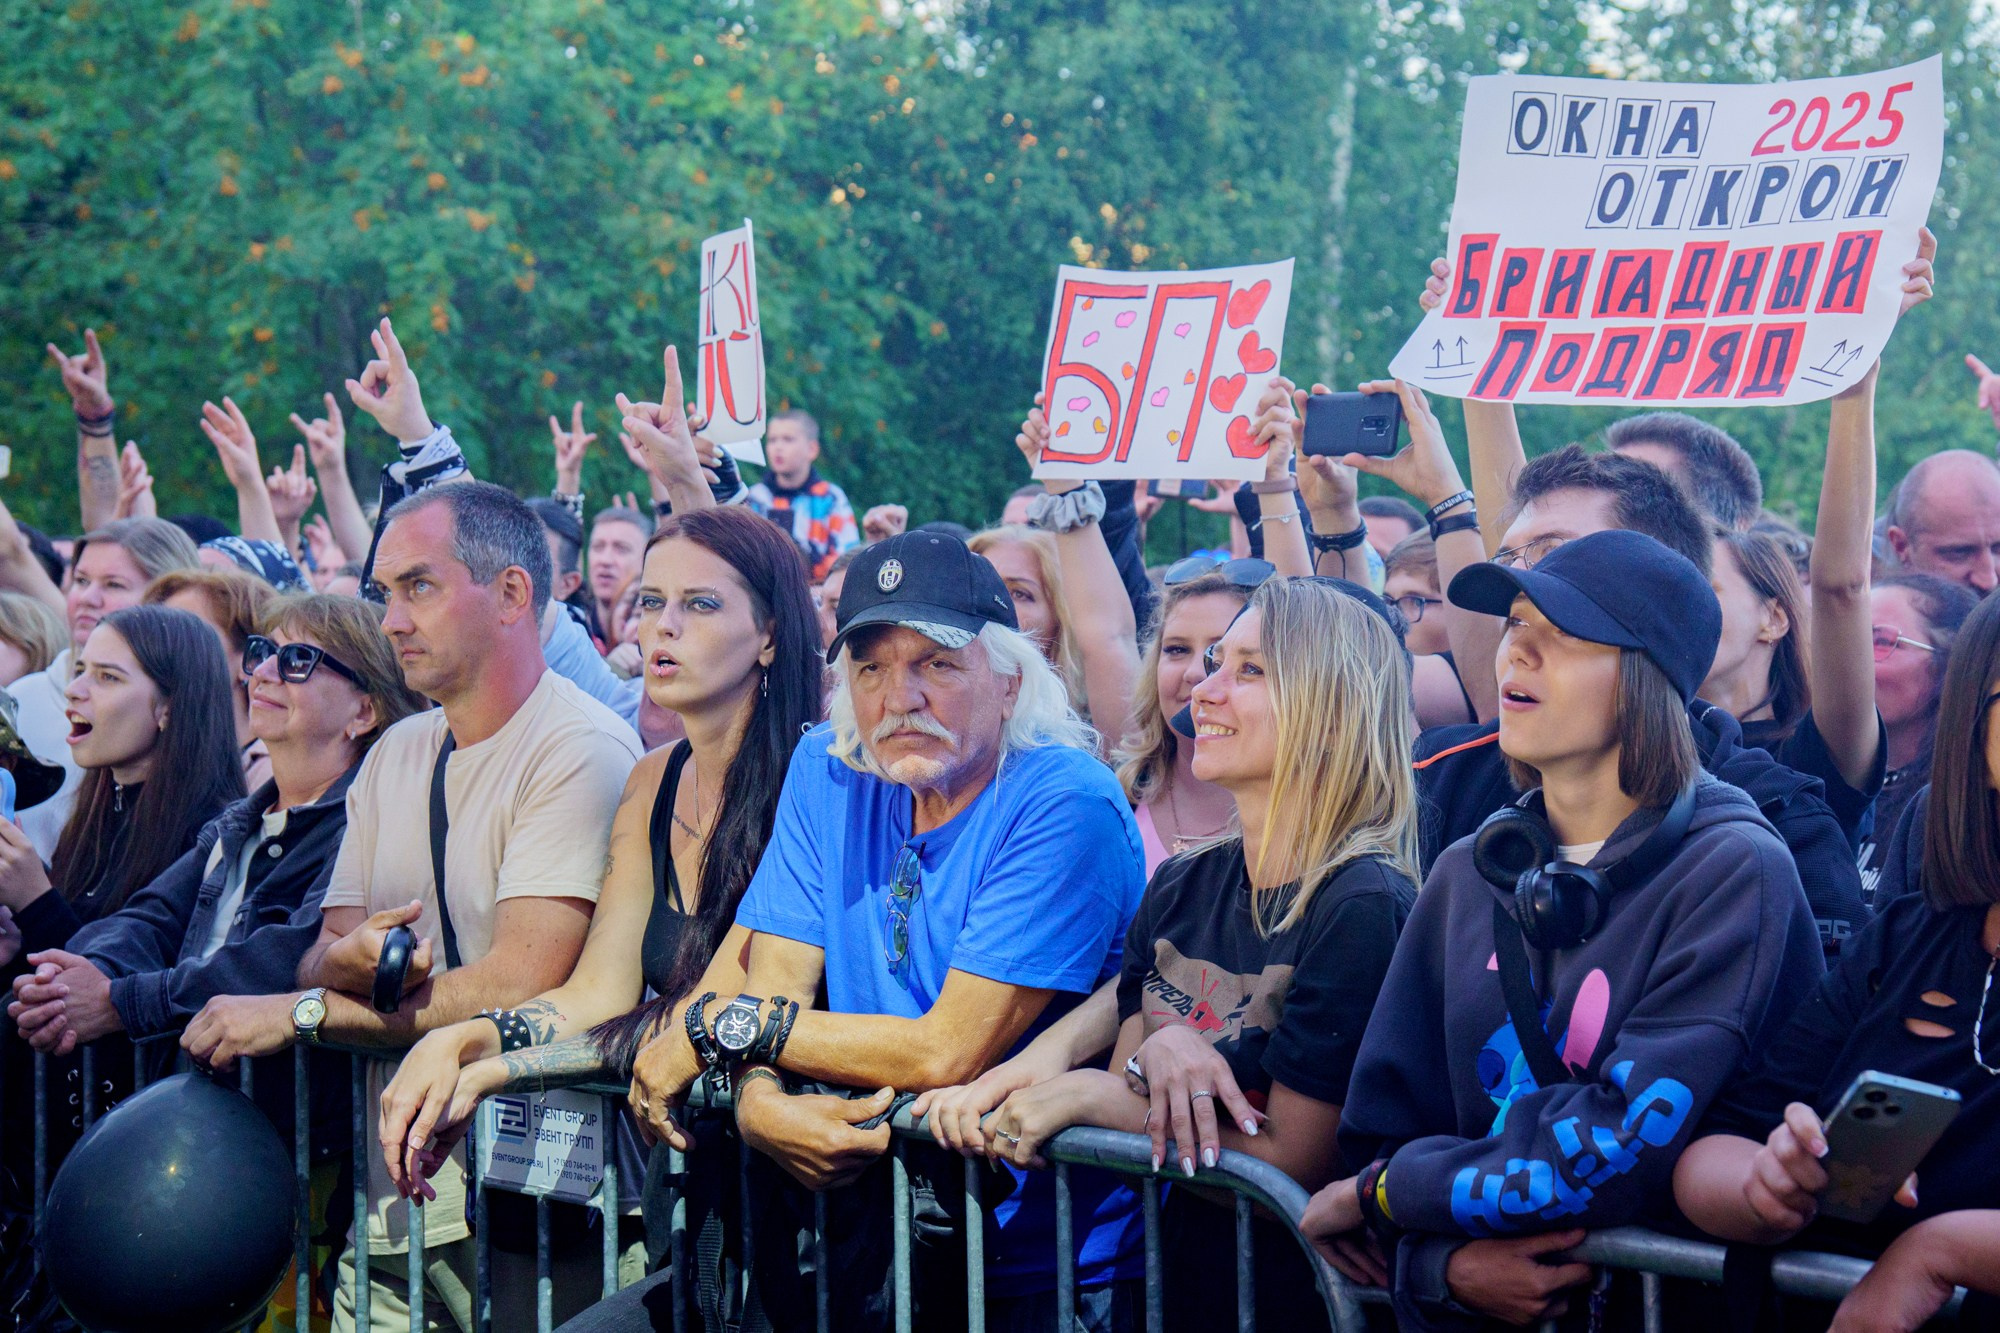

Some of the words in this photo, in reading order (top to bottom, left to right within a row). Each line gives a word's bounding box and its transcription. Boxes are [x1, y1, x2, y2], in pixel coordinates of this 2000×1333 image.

[1514, 96, 1699, 156] ОКНА
[1751, 81, 1914, 157] 2025
[1596, 155, 1904, 227] ОТКРОЙ
[1451, 233, 1881, 315] БРИГАДНЫЙ
[1040, 279, 1233, 465] БП
[1473, 327, 1796, 398] ПОДРЯД
[533, 1104, 562, 1122] EVENT
[564, 1111, 598, 1127] GROUP
[534, 1128, 562, 1145] ЭВЕНТ
[564, 1133, 594, 1150] ГРУПП
